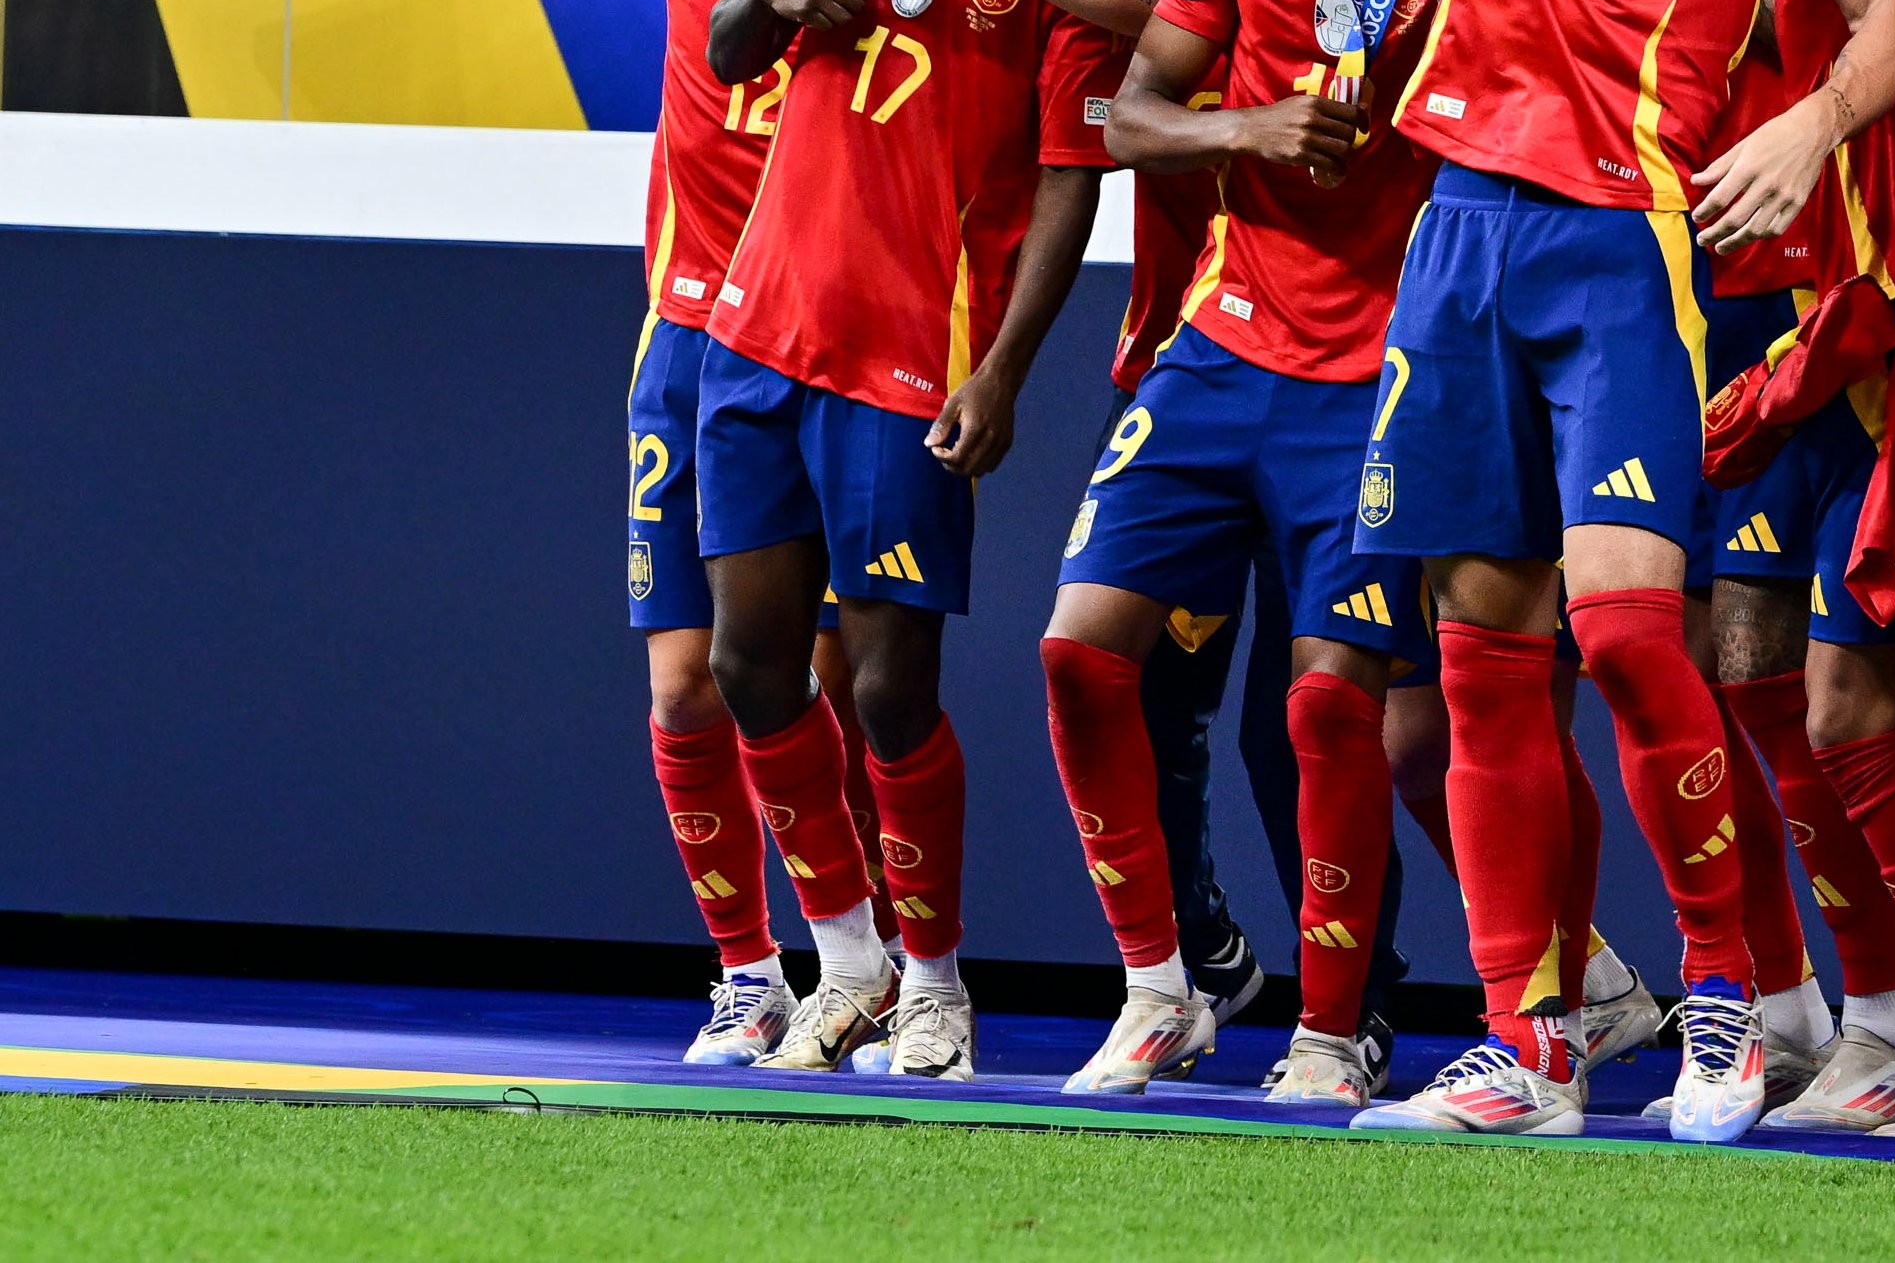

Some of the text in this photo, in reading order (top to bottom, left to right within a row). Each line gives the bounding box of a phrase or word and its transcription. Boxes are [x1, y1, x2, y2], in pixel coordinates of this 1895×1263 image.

[724, 58, 792, 136] 12
[851, 26, 932, 124] 17
[1598, 157, 1639, 182] HEAT.RDY
[1784, 246, 1810, 258] HEAT.
[893, 367, 934, 393] HEAT.RDY
[1372, 347, 1411, 442] 7
[1090, 405, 1153, 485] 9
